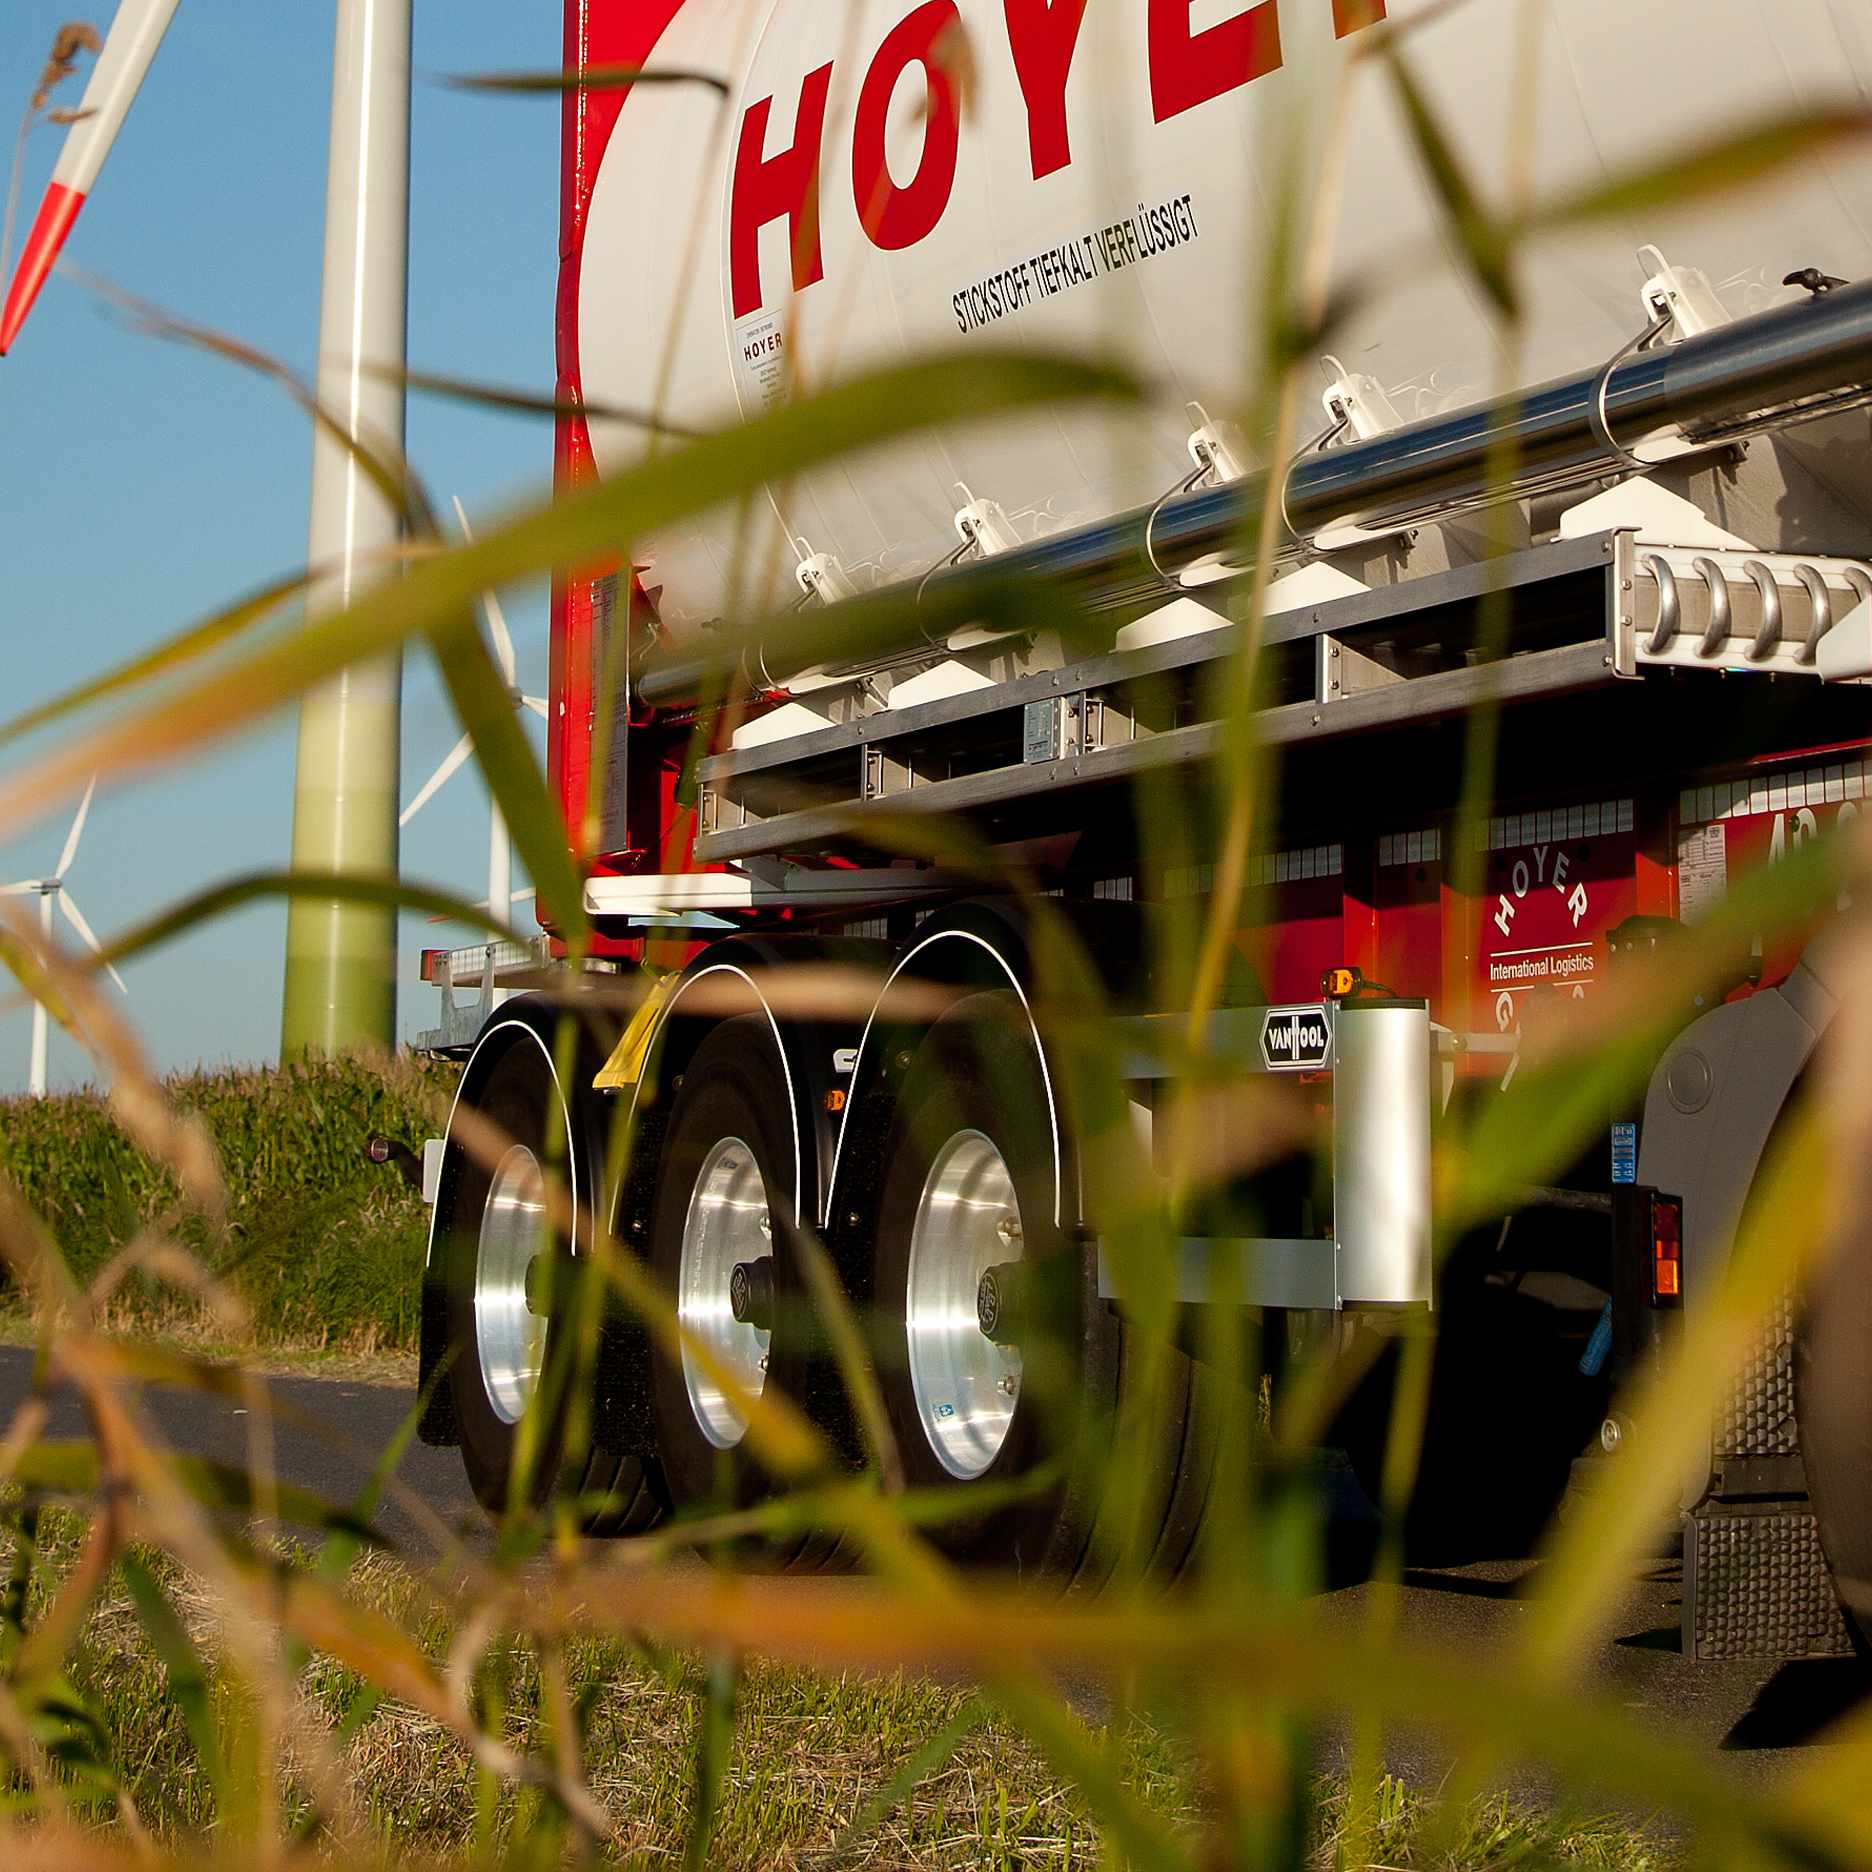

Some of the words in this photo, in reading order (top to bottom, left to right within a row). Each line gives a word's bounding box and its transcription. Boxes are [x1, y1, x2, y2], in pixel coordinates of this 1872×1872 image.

[952, 264, 1031, 333] STICKSTOFF
[1030, 236, 1099, 298] TIEFKALT
[1094, 194, 1199, 272] VERFLÜSSIGT
[744, 332, 783, 360] HOYER
[1494, 846, 1588, 937] HOYER
[1490, 960, 1548, 981] International
[1550, 953, 1594, 977] Logistics
